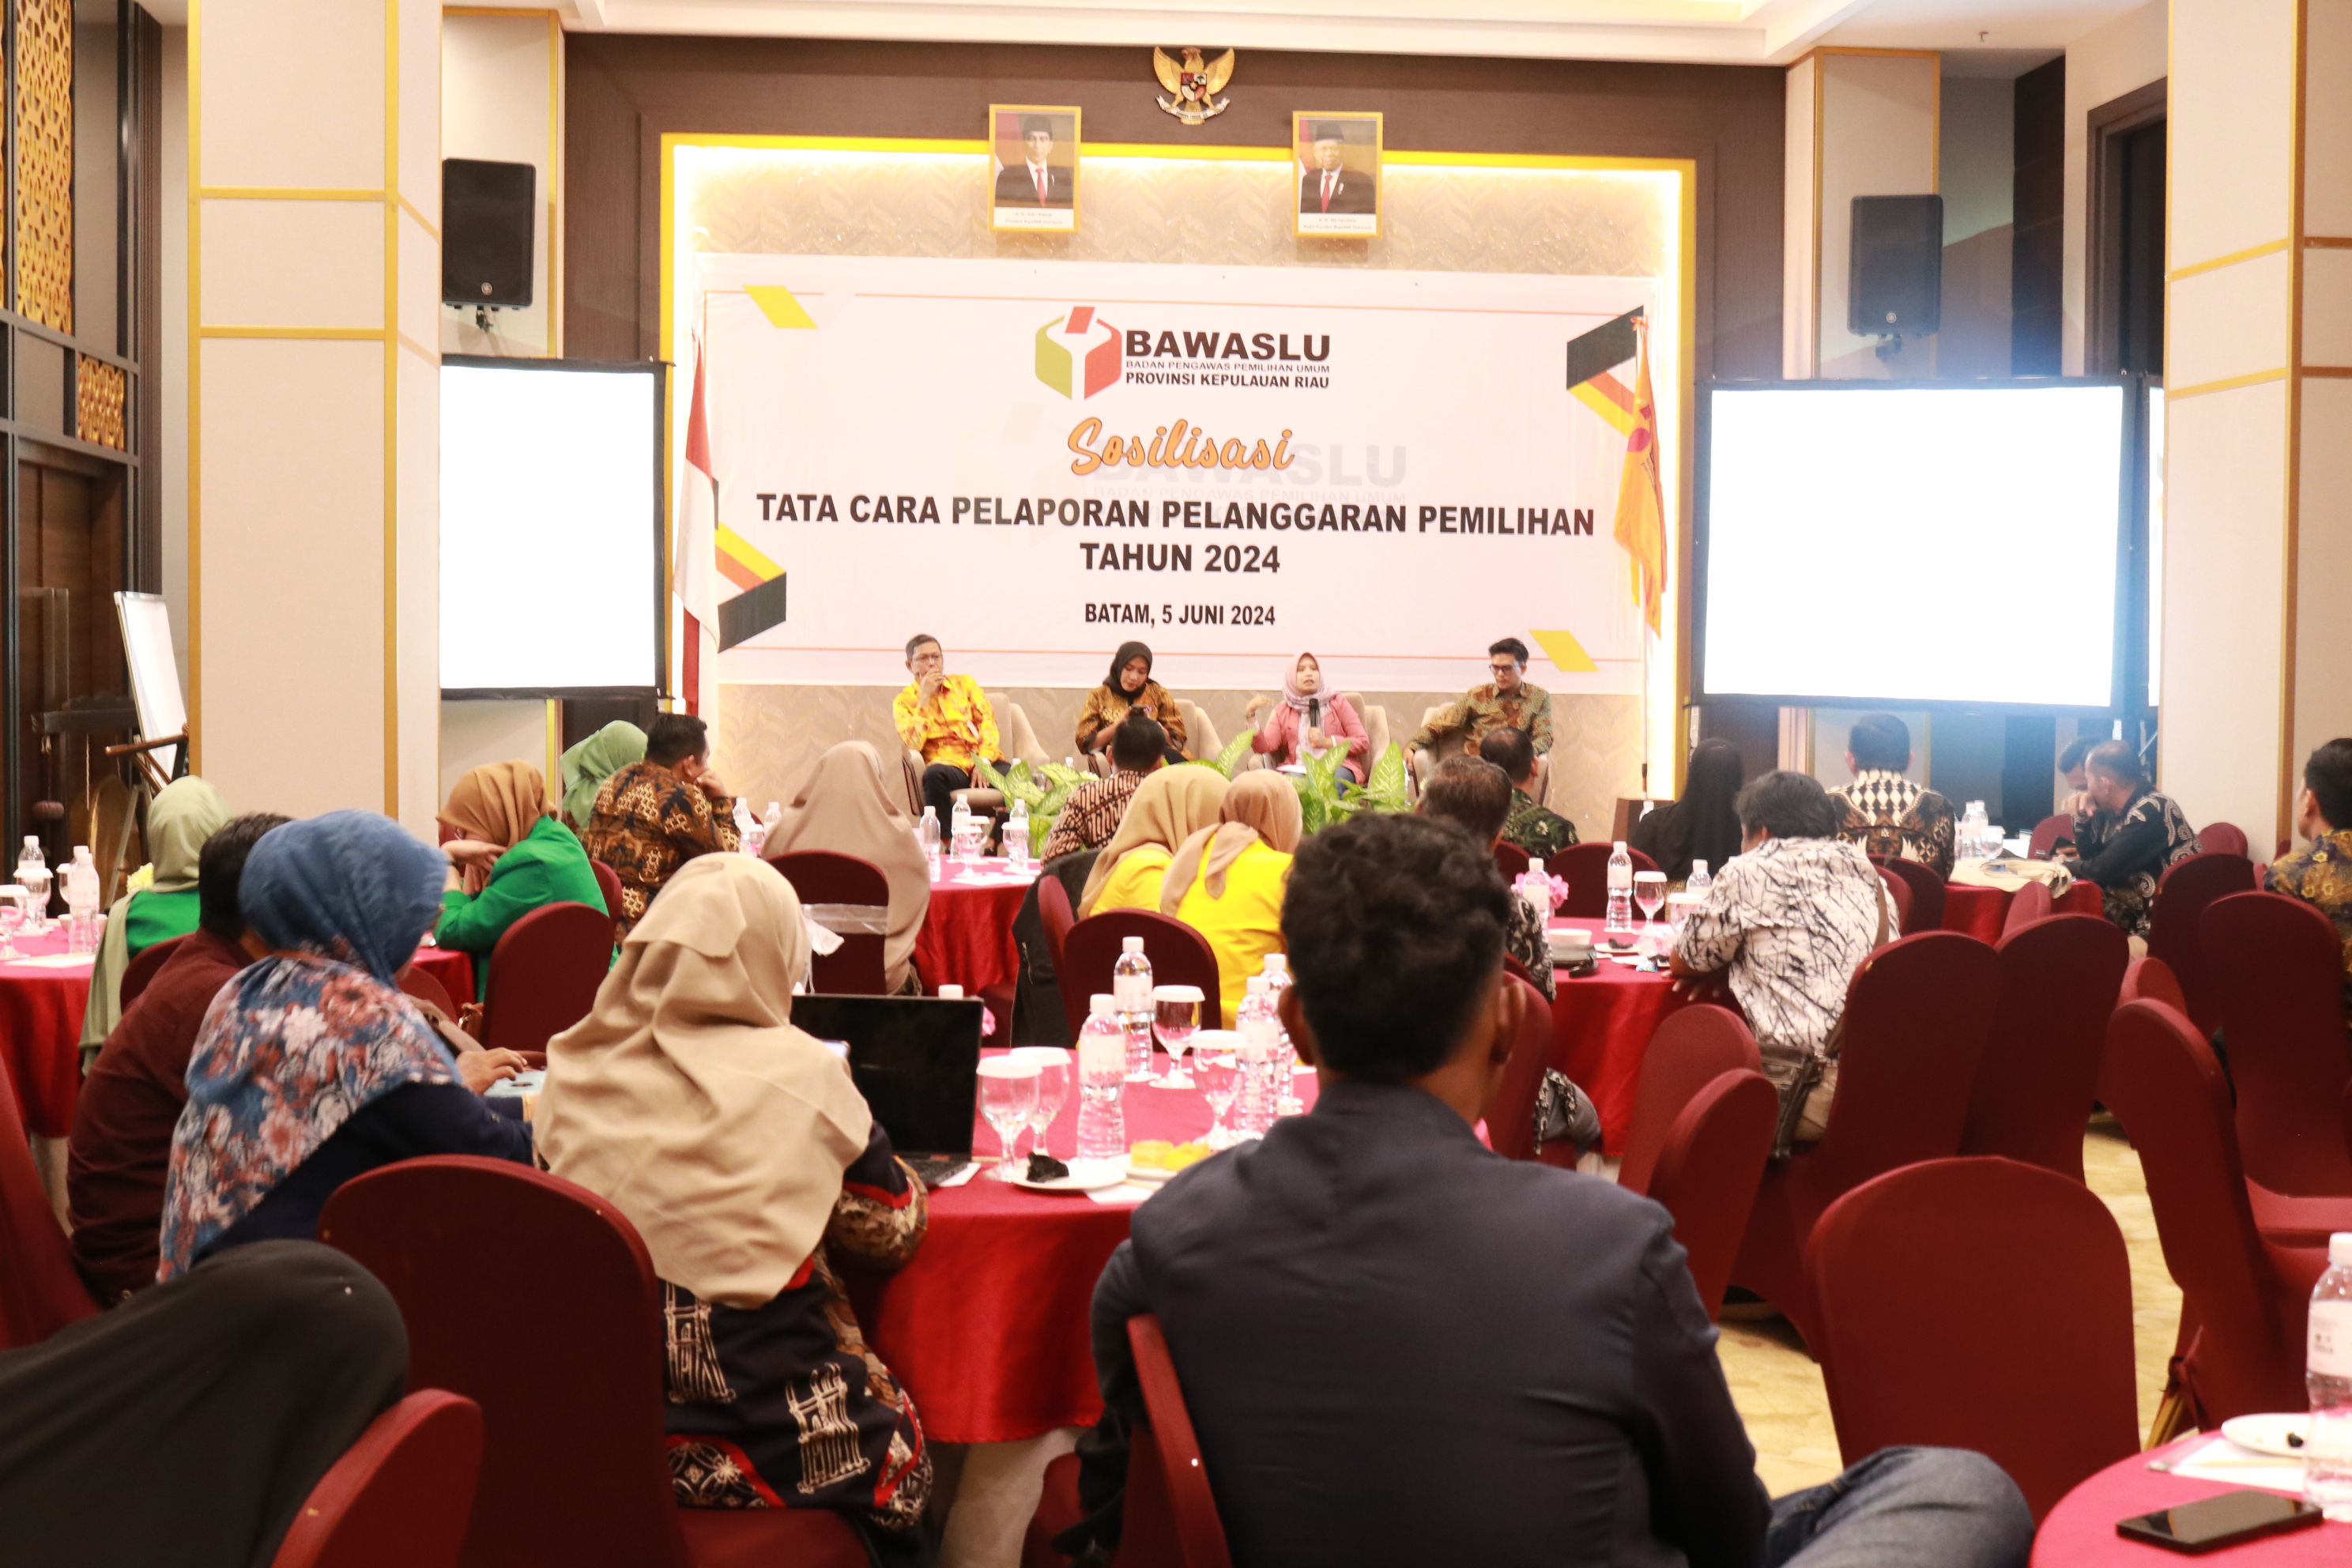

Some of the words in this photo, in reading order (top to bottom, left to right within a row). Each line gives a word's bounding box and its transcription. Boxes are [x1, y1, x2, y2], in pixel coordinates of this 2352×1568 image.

[1126, 330, 1330, 361] BAWASLU
[1126, 360, 1165, 369] BADAN
[1168, 362, 1231, 371] PENGAWAS
[1234, 363, 1293, 372] PEMILIHAN
[1296, 364, 1330, 373] UMUM
[1126, 372, 1195, 385] PROVINSI
[1200, 374, 1290, 387] KEPULAUAN
[1295, 376, 1329, 388] RIAU
[1068, 416, 1295, 476] Sosilisasi
[756, 493, 839, 522] TATA
[850, 495, 940, 523] CARA
[952, 497, 1150, 527] PELAPORAN
[1163, 501, 1406, 532] PELANGGARAN
[1419, 506, 1594, 536] PEMILIHAN
[1080, 543, 1192, 571] TAHUN
[1204, 545, 1280, 573] 2024
[1085, 603, 1155, 628] BATAM,
[1162, 604, 1173, 624] 5
[1178, 605, 1224, 625] JUNI
[1231, 605, 1276, 625] 2024
